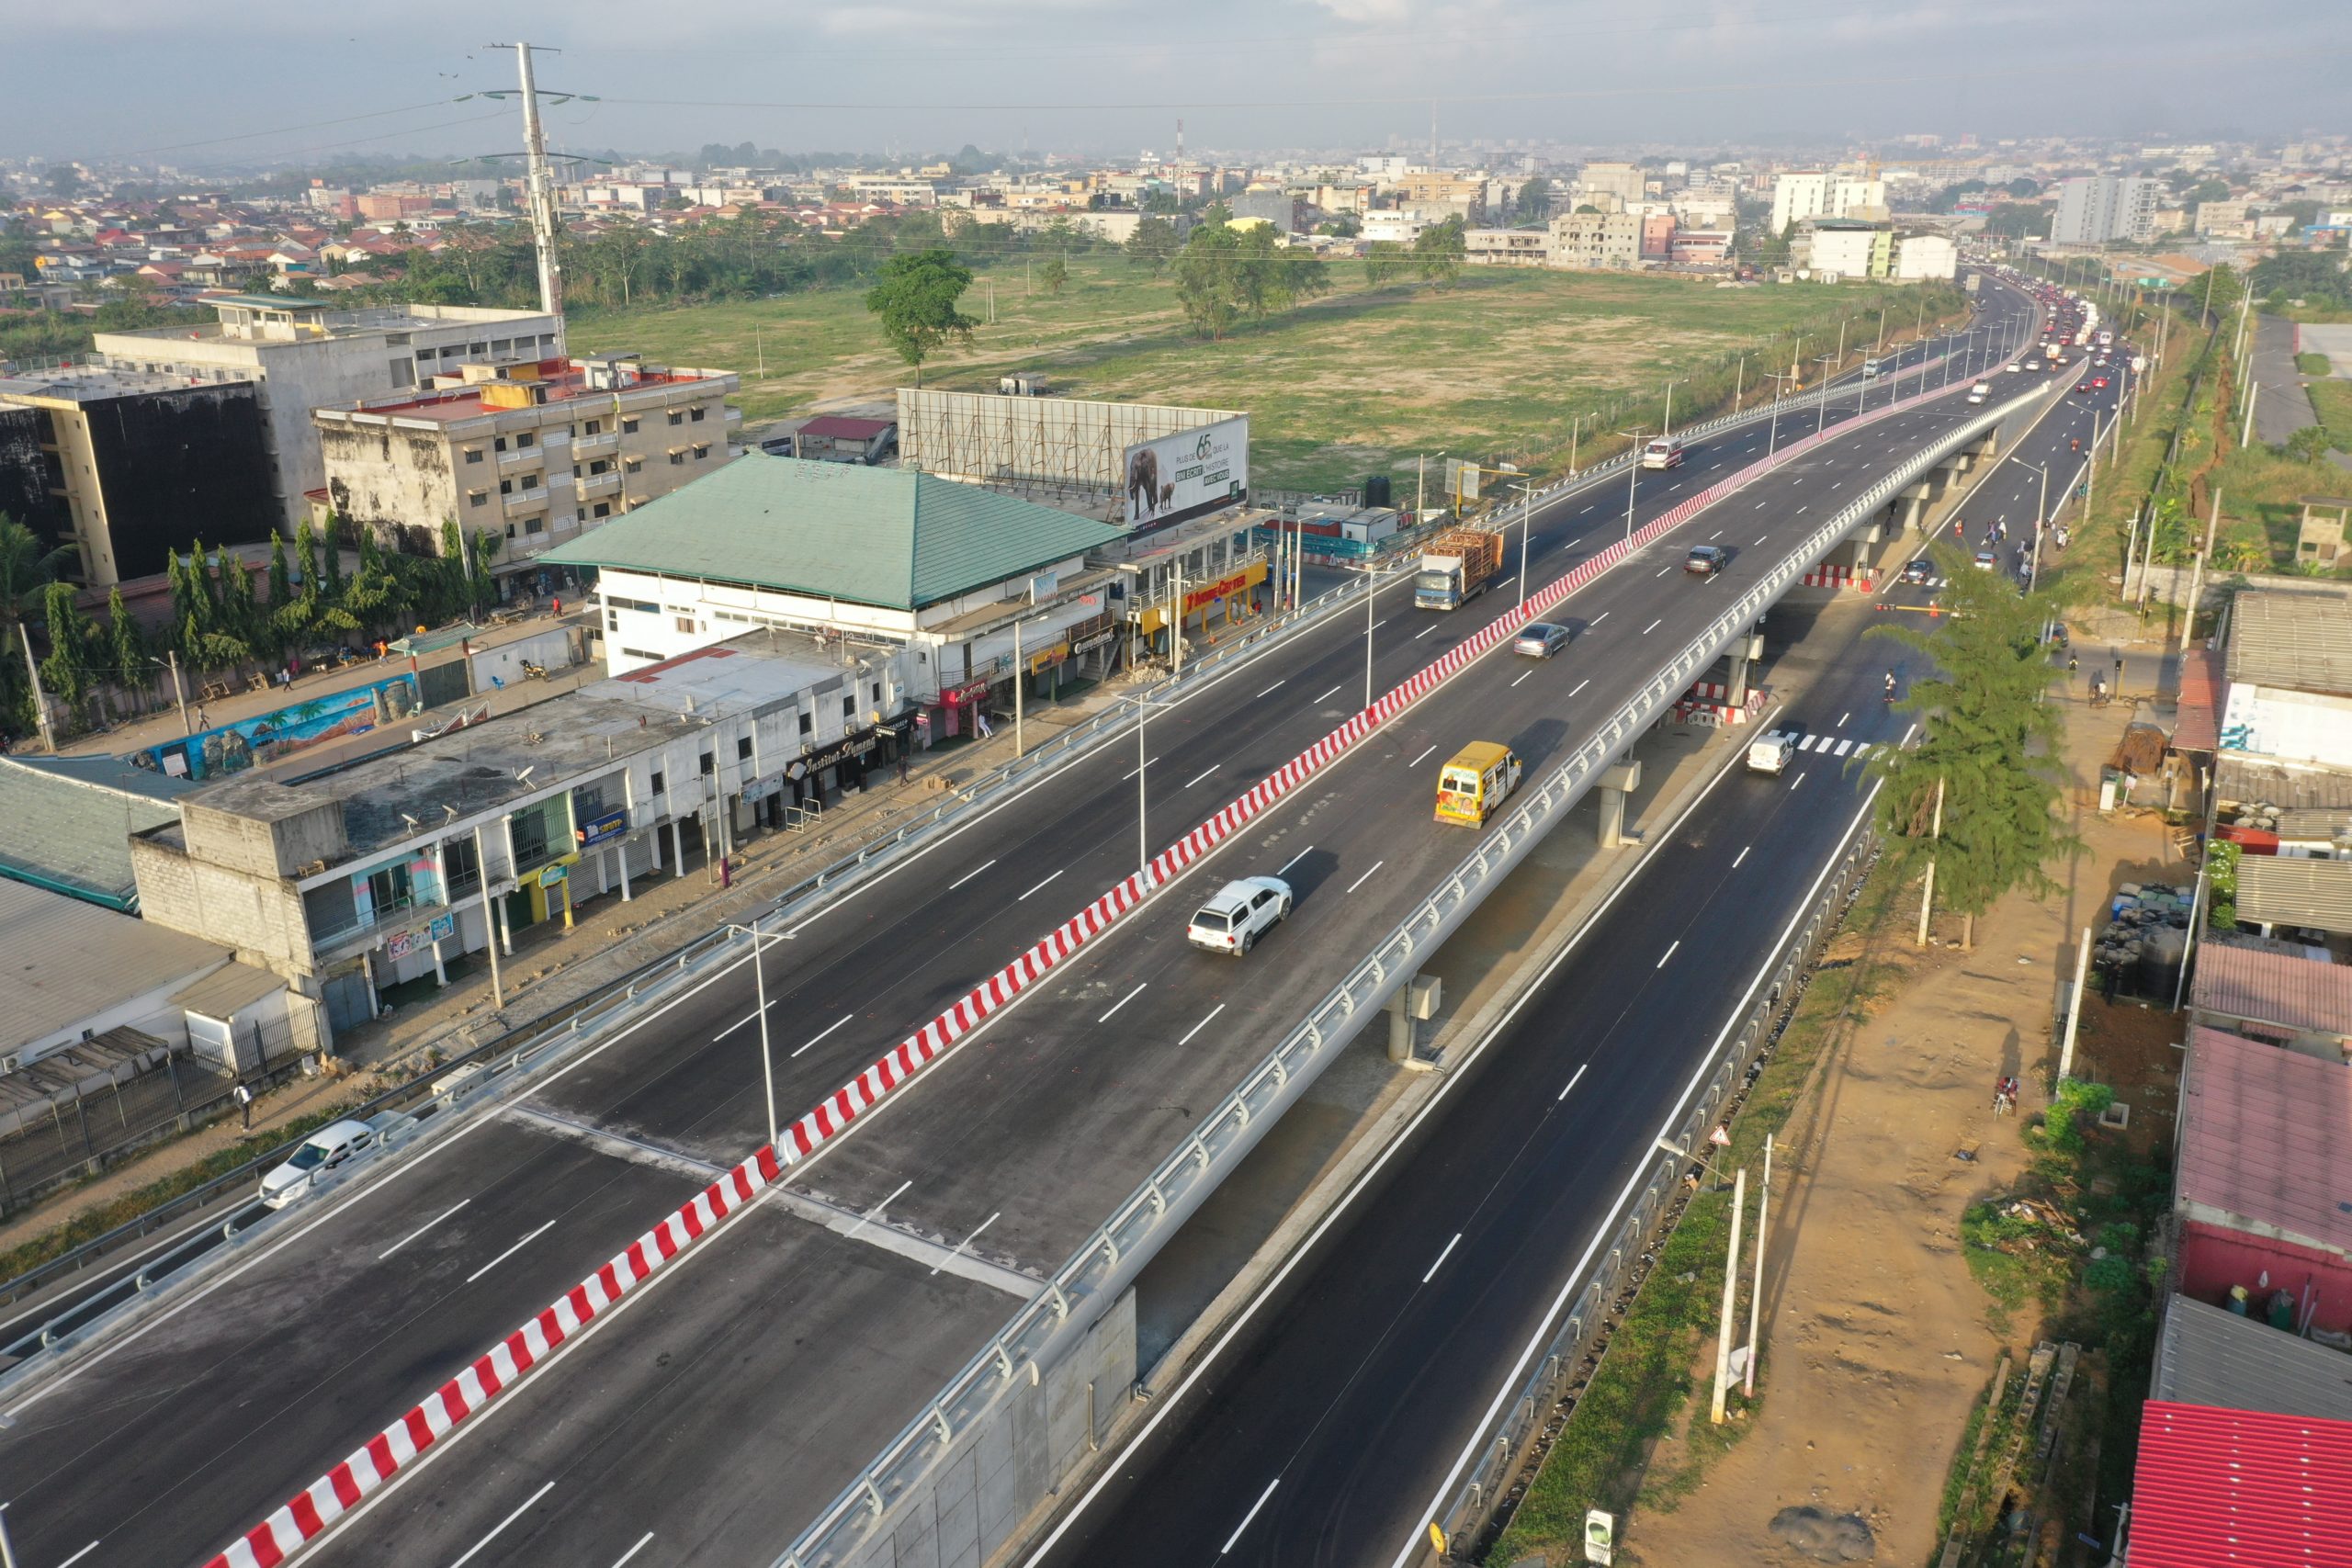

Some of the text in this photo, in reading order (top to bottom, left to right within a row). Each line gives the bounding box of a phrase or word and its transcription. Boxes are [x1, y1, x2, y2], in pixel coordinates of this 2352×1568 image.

[1176, 455, 1189, 465] PLUS
[1196, 434, 1211, 460] 65
[1213, 444, 1222, 454] QUE
[1216, 470, 1229, 481] VOUS
[876, 728, 896, 736] CANAL+
[806, 750, 841, 774] Institut
